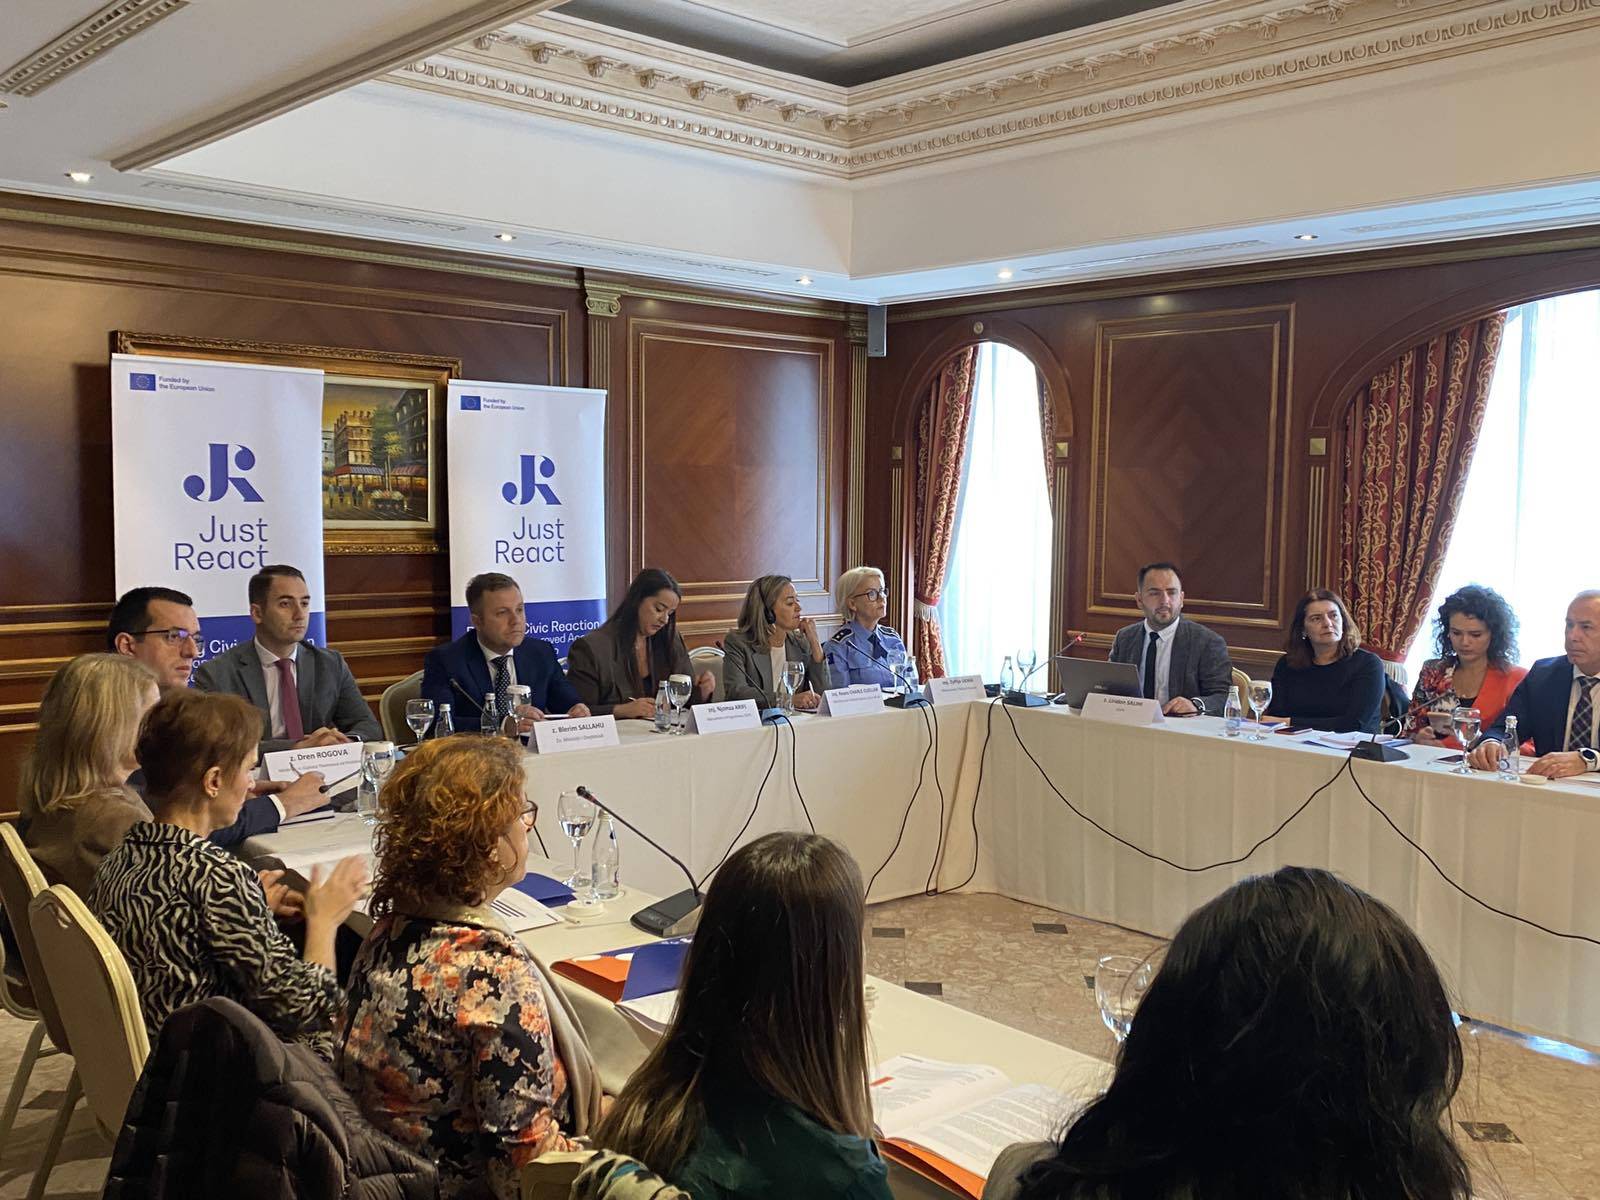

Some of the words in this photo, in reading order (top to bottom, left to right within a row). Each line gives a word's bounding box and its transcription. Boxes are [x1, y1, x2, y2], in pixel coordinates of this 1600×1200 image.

[199, 515, 268, 543] Just
[512, 516, 565, 540] Just
[174, 543, 268, 570] React
[495, 540, 565, 564] React
[551, 620, 600, 632] Reaction
[578, 722, 604, 731] SALLAHU
[297, 753, 315, 761] Dren
[316, 749, 348, 759] ROGOVA
